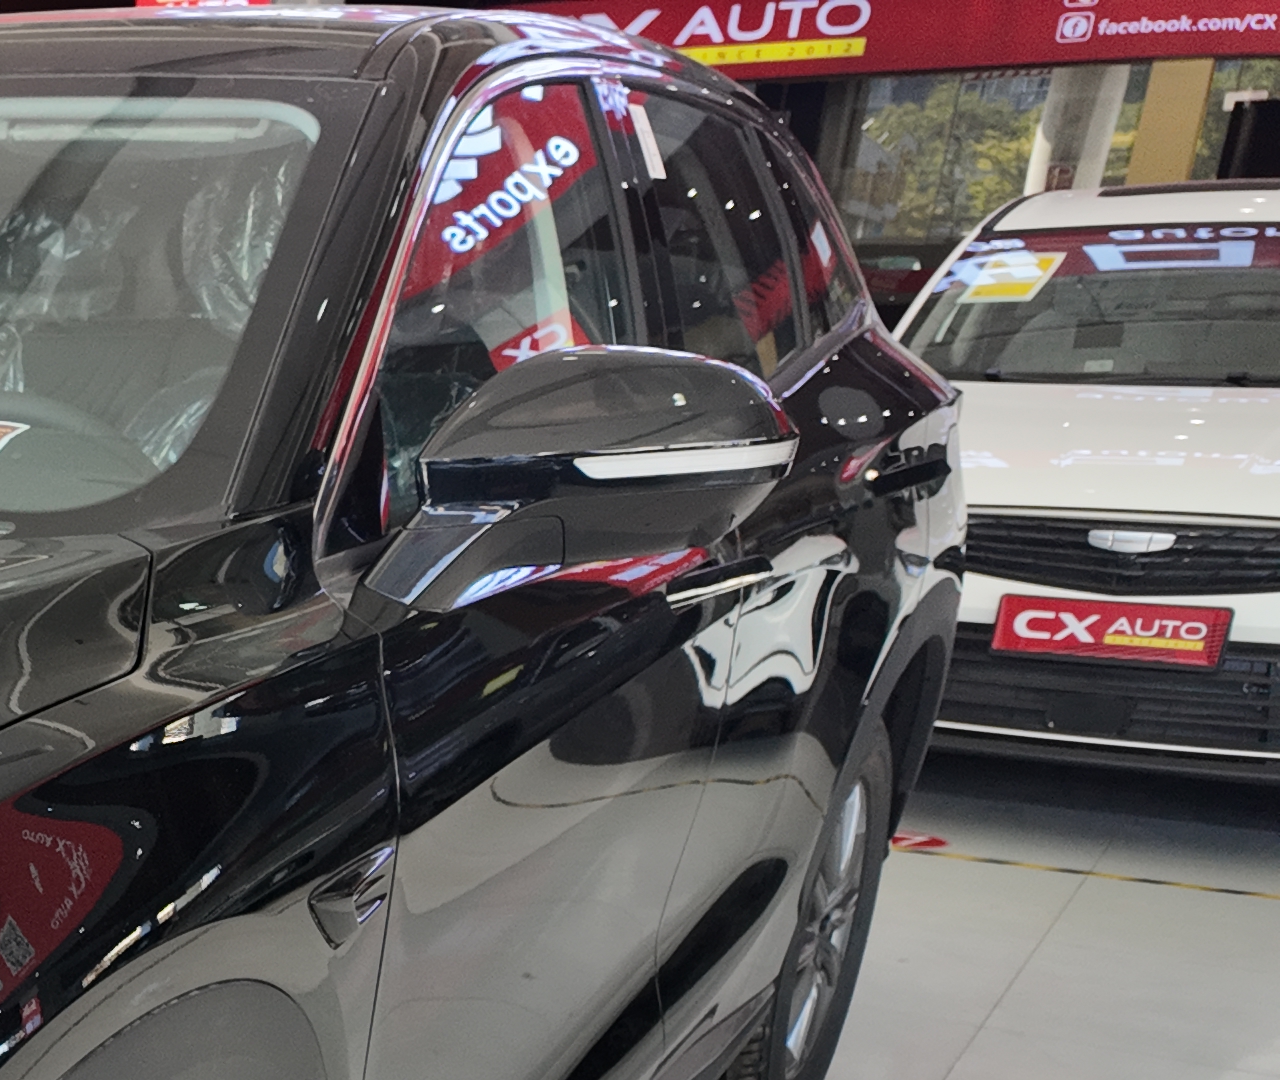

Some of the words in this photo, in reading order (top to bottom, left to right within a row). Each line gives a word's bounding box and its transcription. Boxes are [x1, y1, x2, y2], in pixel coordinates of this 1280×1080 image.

[673, 1, 871, 46] AUTO
[1013, 610, 1100, 643] CX
[1107, 617, 1207, 640] AUTO
